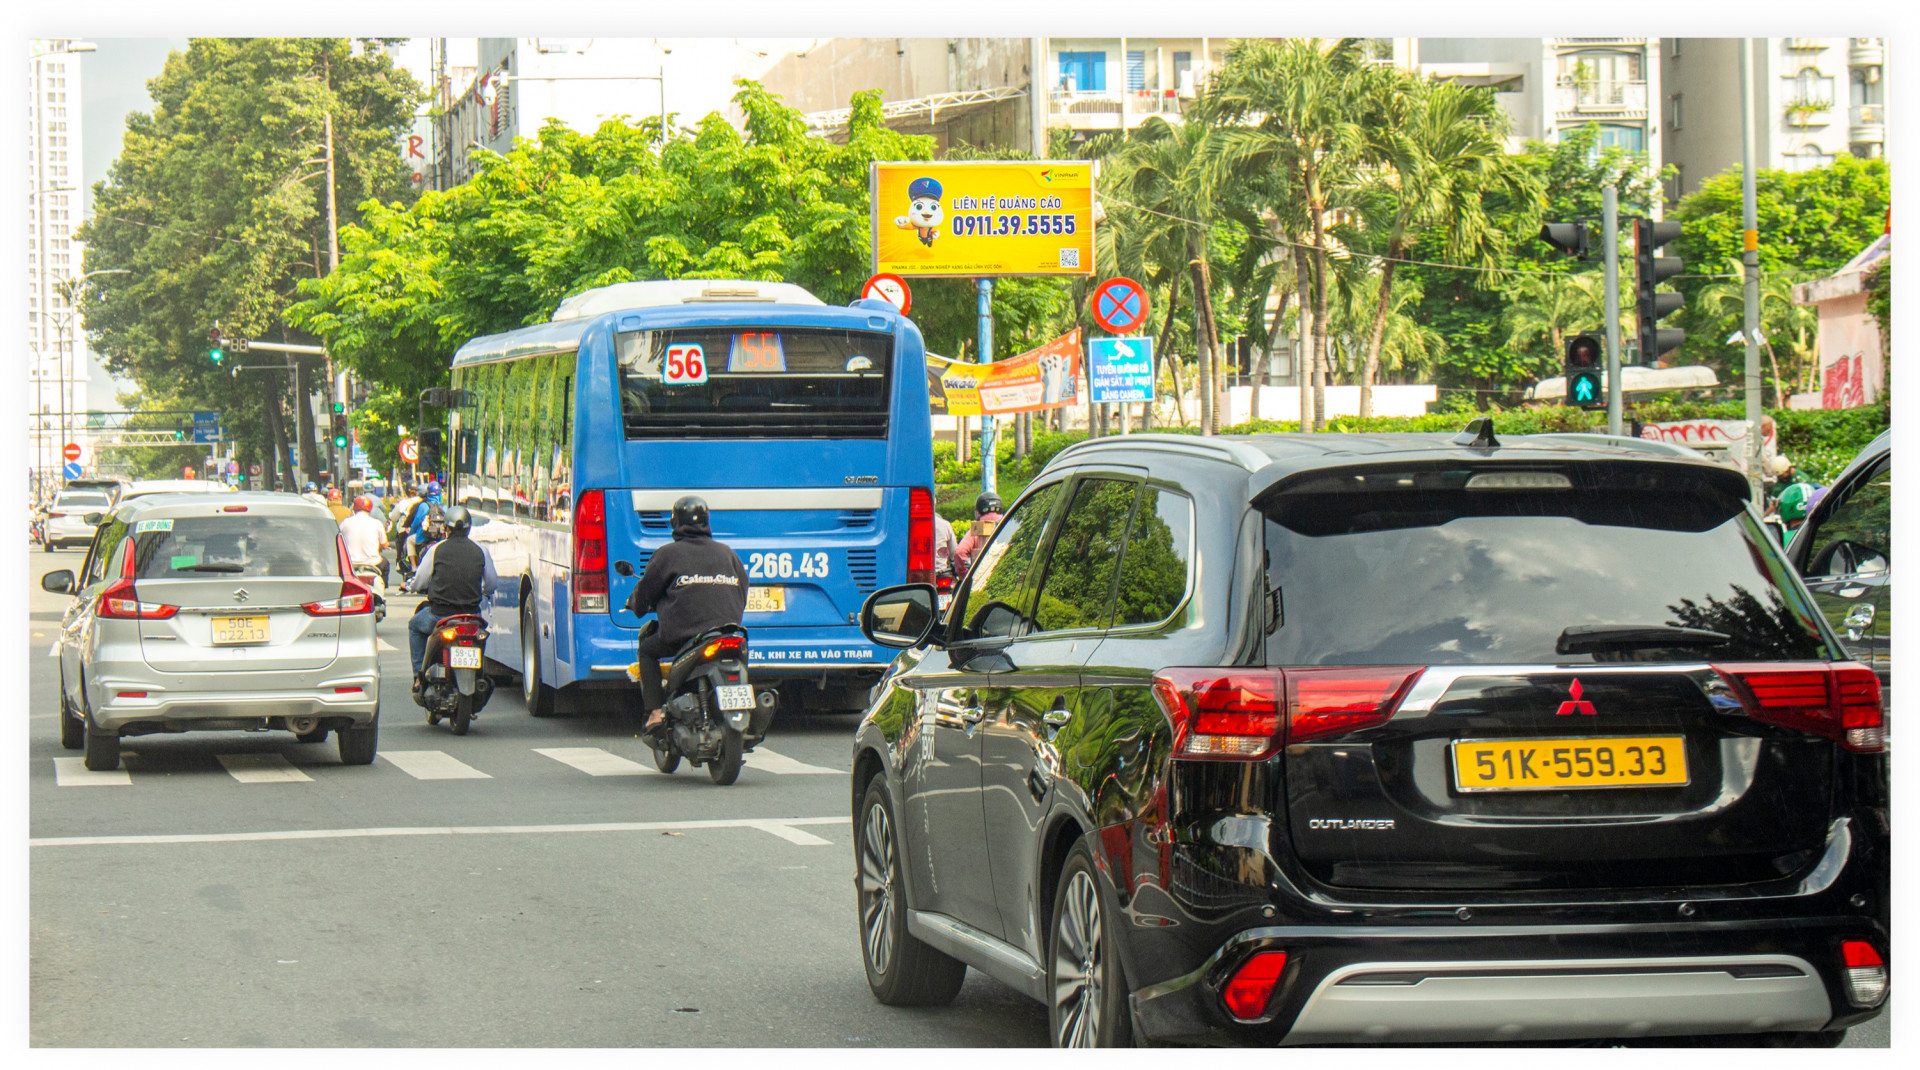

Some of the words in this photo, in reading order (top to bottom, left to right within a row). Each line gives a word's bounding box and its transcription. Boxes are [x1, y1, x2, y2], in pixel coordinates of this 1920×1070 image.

[953, 195, 978, 210] LIÊN
[981, 195, 996, 213] HỆ
[999, 195, 1036, 210] QUẢNG
[1040, 194, 1061, 209] CÁO
[953, 214, 1076, 236] 0911.39.5555
[742, 332, 777, 367] 56
[667, 348, 703, 379] 56
[1096, 361, 1117, 375] TUYẾN
[1139, 360, 1149, 374] CÓ
[1094, 375, 1111, 388] GIÁM
[1134, 375, 1152, 389] PHẠT
[1101, 386, 1119, 400] BẰNG
[1119, 388, 1146, 400] CAMERA
[746, 600, 780, 610] 66.43
[228, 617, 253, 629] 50E
[219, 629, 265, 641] 022.13
[767, 651, 786, 660] KHI
[788, 651, 801, 659] XE
[804, 651, 818, 659] RA
[820, 649, 841, 659] VÀO
[843, 649, 873, 660] TRẠM
[1476, 745, 1668, 780] 51K-559.33
[1308, 819, 1396, 830] OUTLANDER
